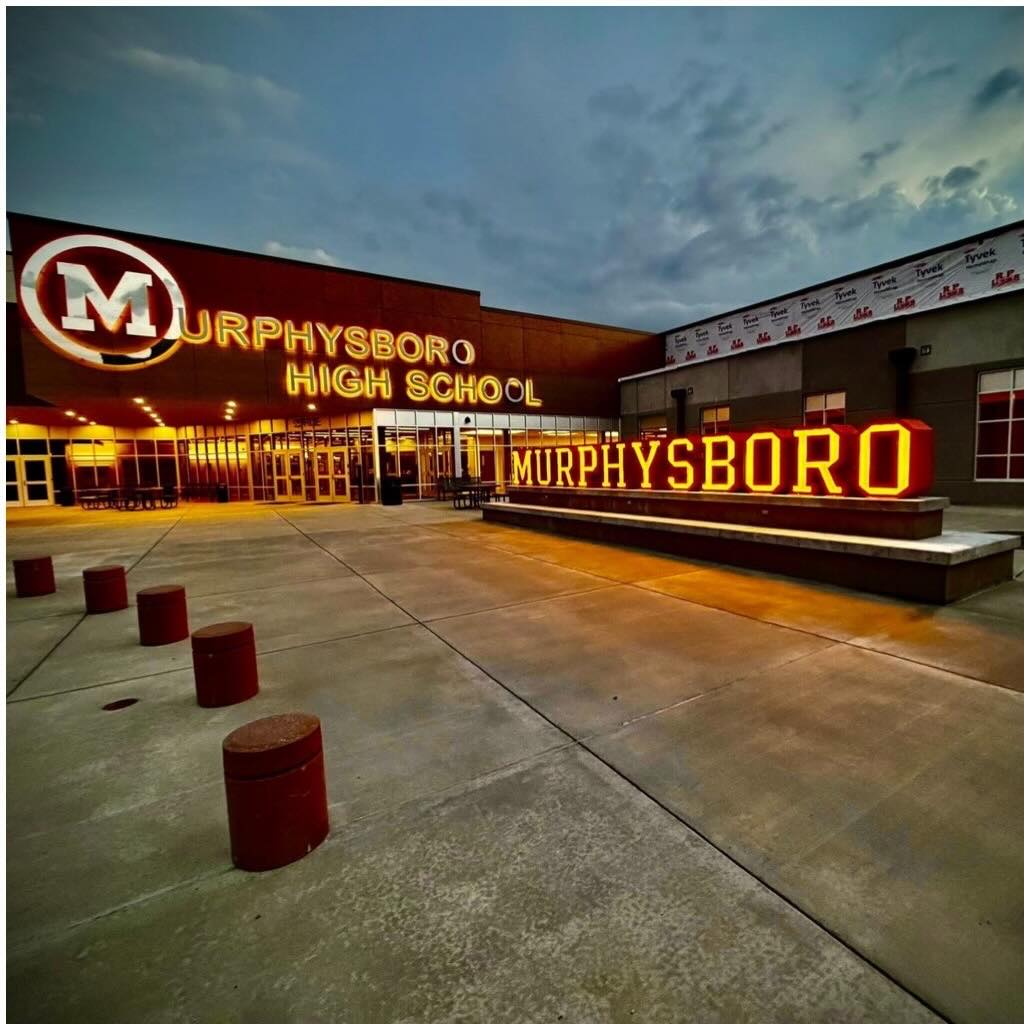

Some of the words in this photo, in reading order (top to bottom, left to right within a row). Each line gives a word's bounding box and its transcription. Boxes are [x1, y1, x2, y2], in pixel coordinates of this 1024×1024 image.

[964, 247, 996, 264] Tyvek
[915, 263, 944, 278] Tyvek
[873, 276, 897, 290] Tyvek
[834, 288, 857, 301] Tyvek
[800, 298, 821, 310] Tyvek
[286, 364, 392, 400] HIGH
[406, 368, 543, 408] SCHOOL
[511, 423, 912, 496] MURPHYSBORO
